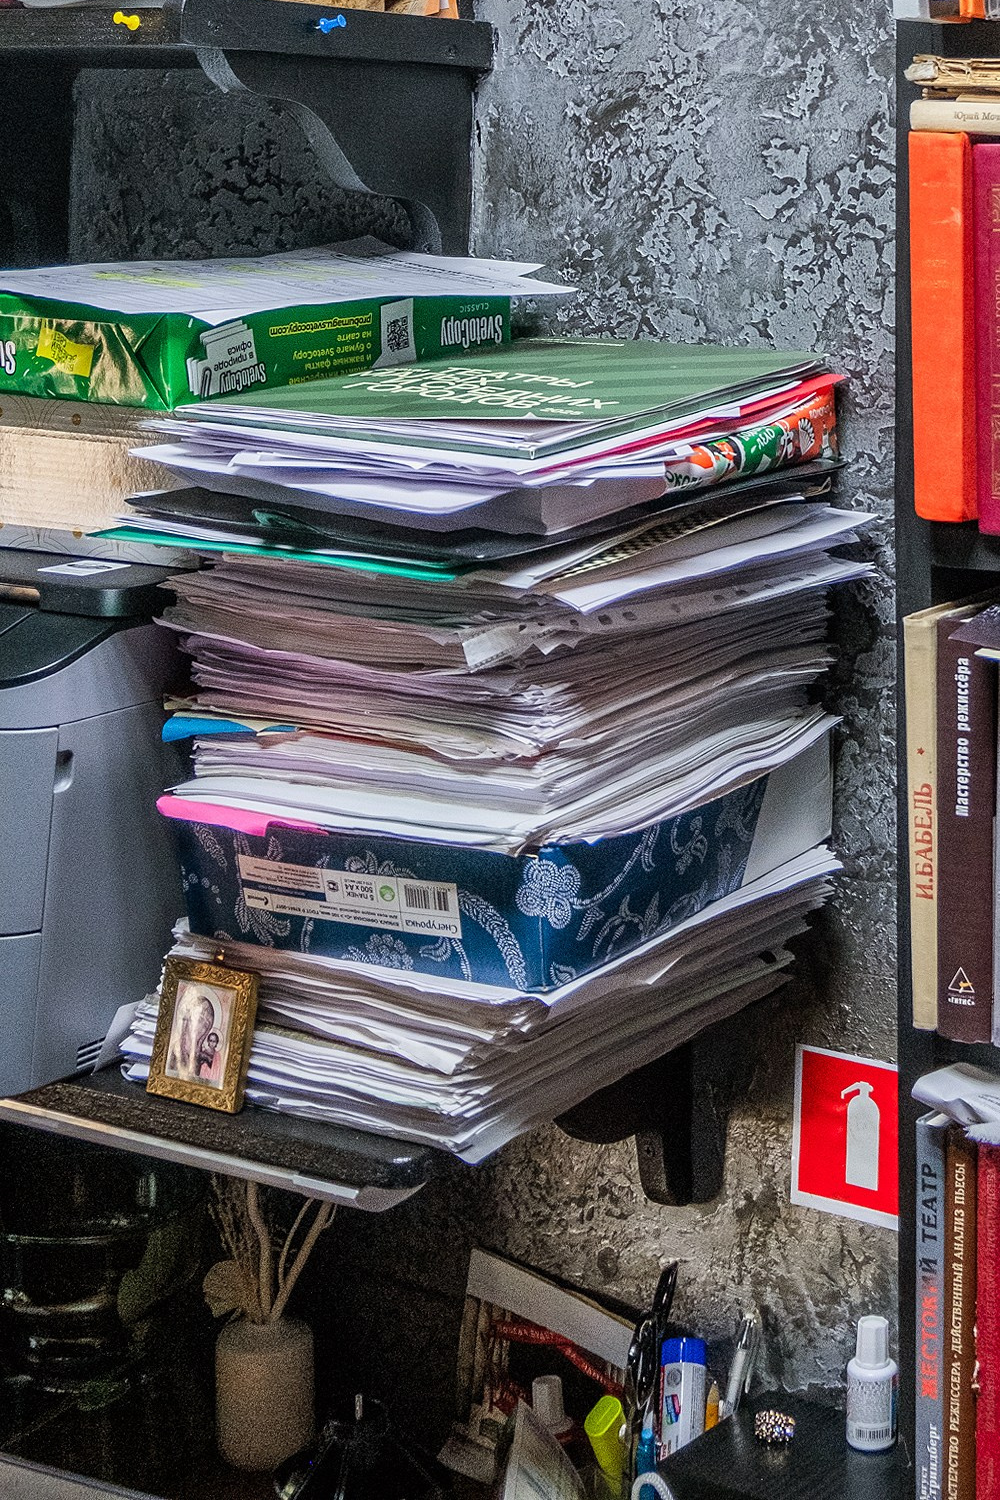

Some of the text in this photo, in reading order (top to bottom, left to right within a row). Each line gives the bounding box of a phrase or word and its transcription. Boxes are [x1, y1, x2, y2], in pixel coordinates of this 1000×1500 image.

[953, 110, 980, 122] Юрий
[459, 302, 490, 314] CLASSIC
[269, 312, 372, 337] probumagu.svetocopy.com
[440, 314, 503, 348] SvetoCopy
[227, 340, 252, 353] офиса
[336, 331, 372, 343] на сайте
[336, 343, 365, 354] бумаге
[214, 355, 247, 372] природе
[292, 345, 335, 361] SvetoCopy
[219, 362, 267, 394] SvetoCopy
[447, 366, 594, 388] ТЕАТРЫ
[342, 382, 541, 409] ГОРОДОВ
[420, 380, 620, 409] СРЕДНИХ
[955, 657, 971, 818] Мастерство режиссёра
[346, 890, 368, 899] ПАЧЕК
[405, 919, 458, 934] Снегурочка
[954, 1163, 966, 1205] ПЬЕСЫ
[953, 1209, 965, 1260] АНАЛИЗ
[918, 1163, 939, 1400] ЖЕСТОКИЙ ТЕАТР
[949, 1361, 961, 1432] РЕЖИССЕРА
